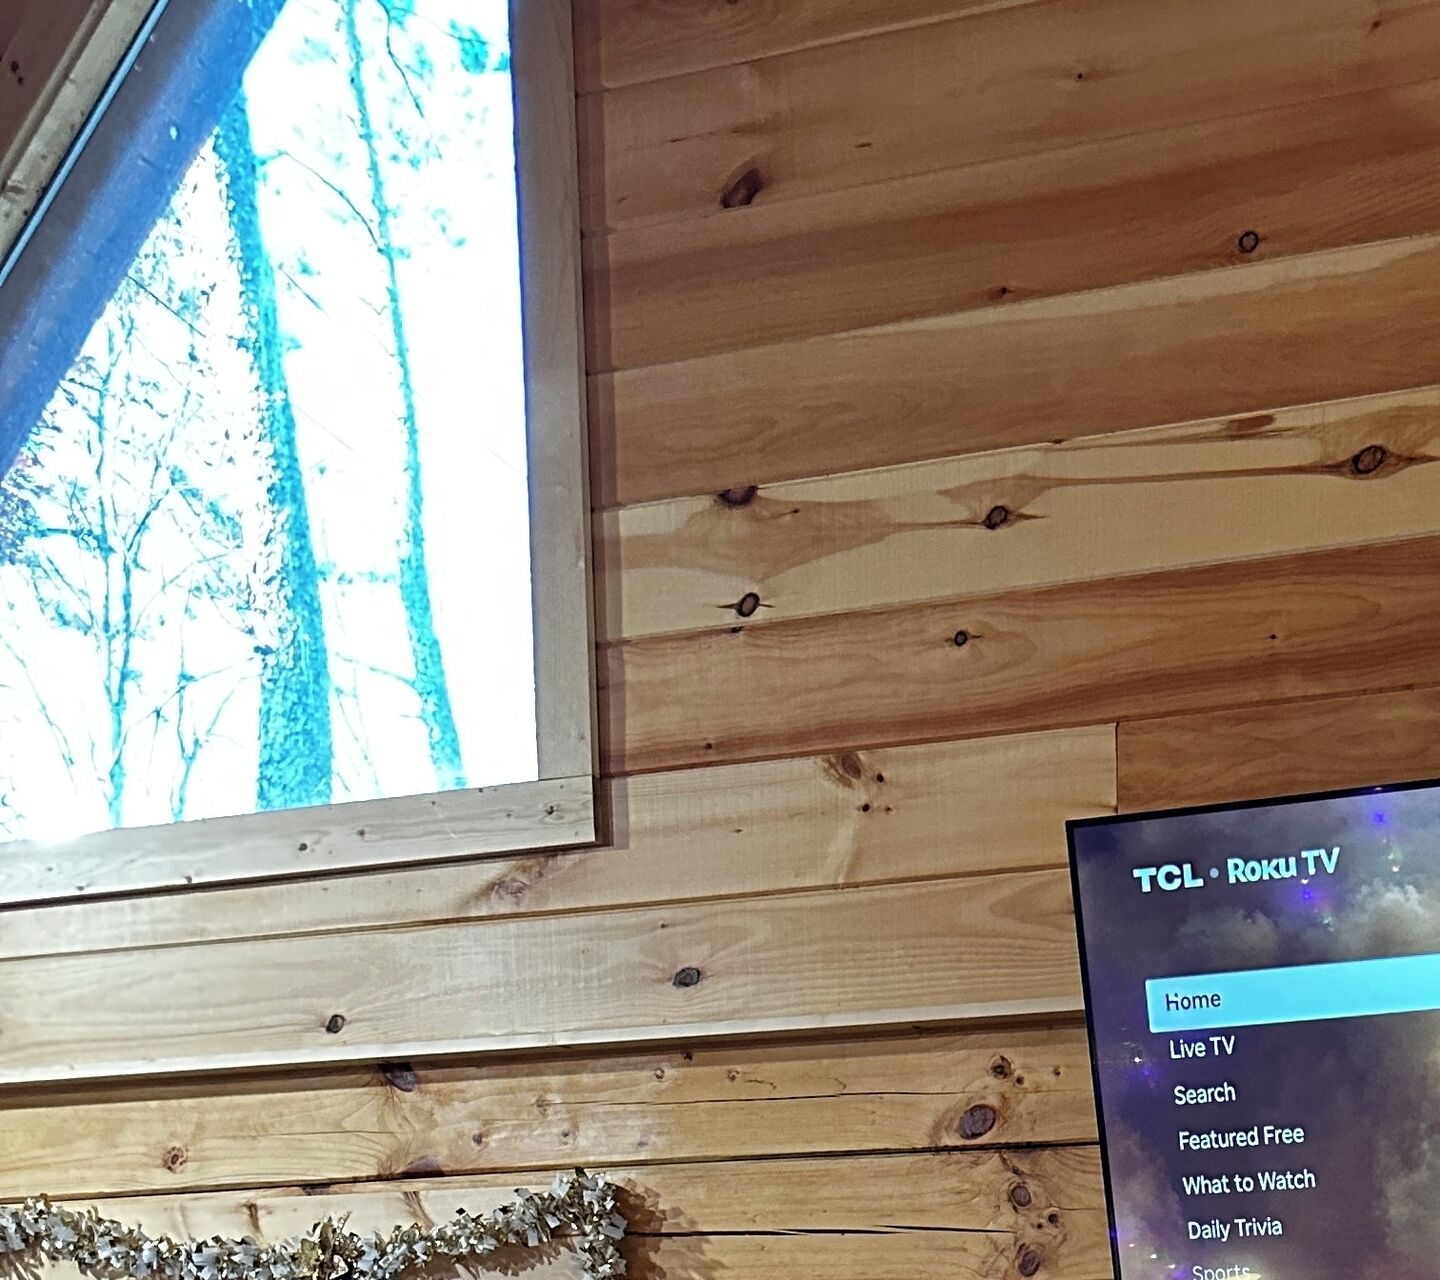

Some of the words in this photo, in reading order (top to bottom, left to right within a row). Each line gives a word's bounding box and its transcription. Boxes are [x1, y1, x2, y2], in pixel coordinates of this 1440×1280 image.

[1133, 864, 1204, 893] TCL
[1301, 847, 1340, 876] TV
[1165, 992, 1221, 1011] Home
[1169, 1038, 1206, 1059] Live
[1209, 1035, 1235, 1055] TV
[1174, 1082, 1236, 1105] Search
[1179, 1126, 1259, 1150] Featured
[1263, 1125, 1305, 1145] Free
[1182, 1175, 1231, 1195] What
[1233, 1174, 1254, 1193] to
[1258, 1169, 1316, 1191] Watch
[1188, 1219, 1231, 1242] Daily
[1234, 1216, 1283, 1237] Trivia
